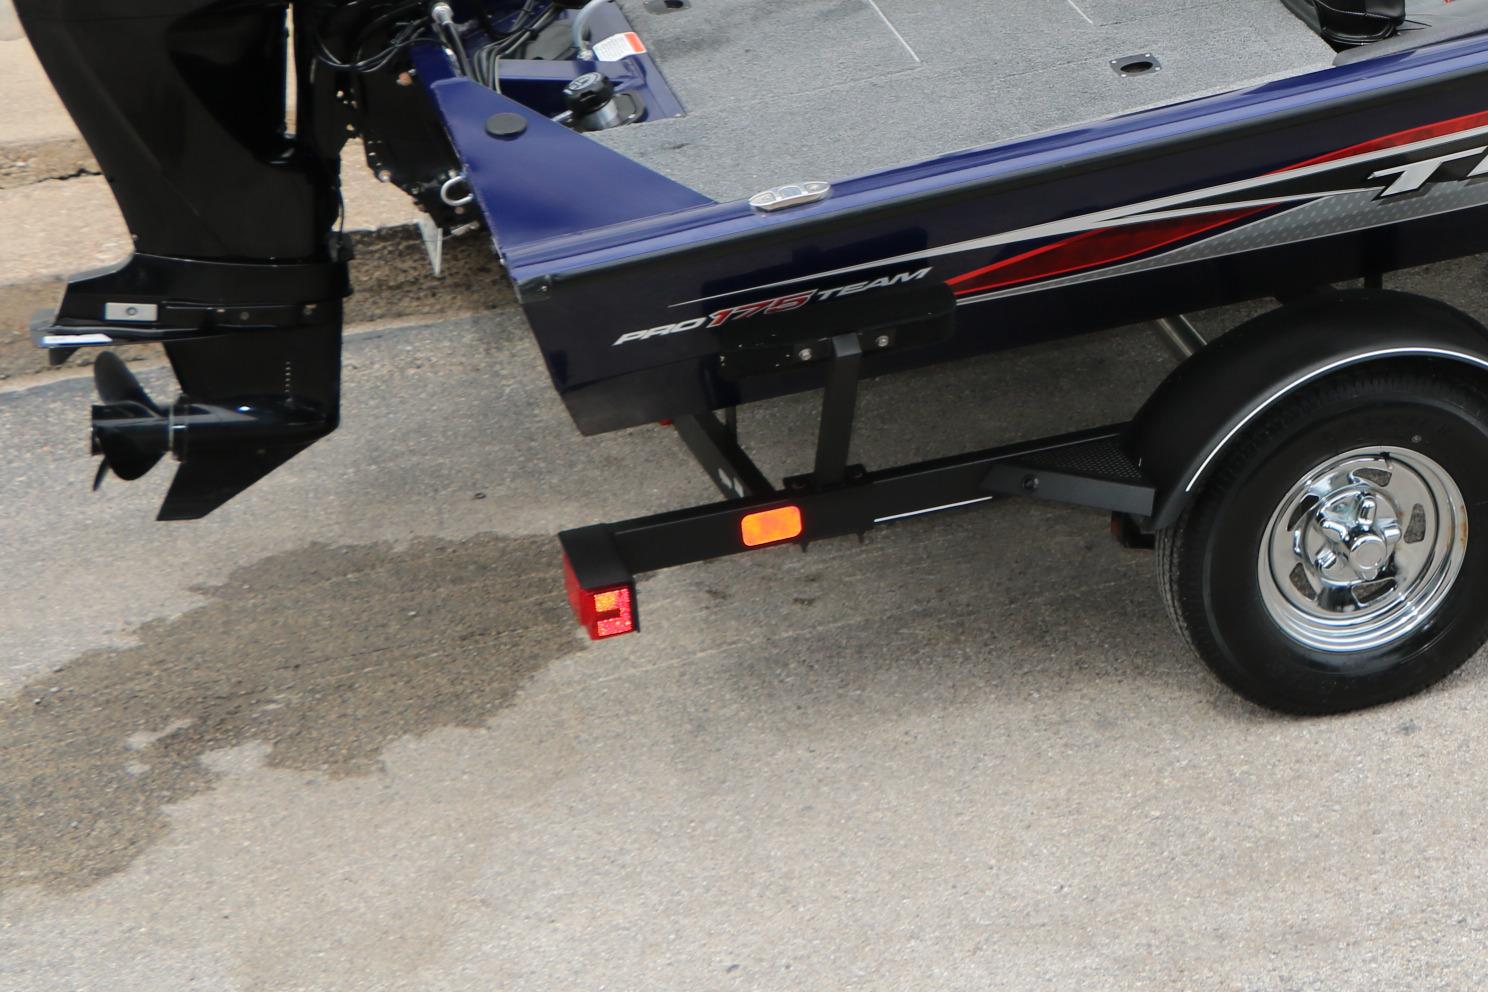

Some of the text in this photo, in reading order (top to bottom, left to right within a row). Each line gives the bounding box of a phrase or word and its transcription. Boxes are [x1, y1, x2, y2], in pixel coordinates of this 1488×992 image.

[612, 267, 933, 346] PRO 175 TEAM
